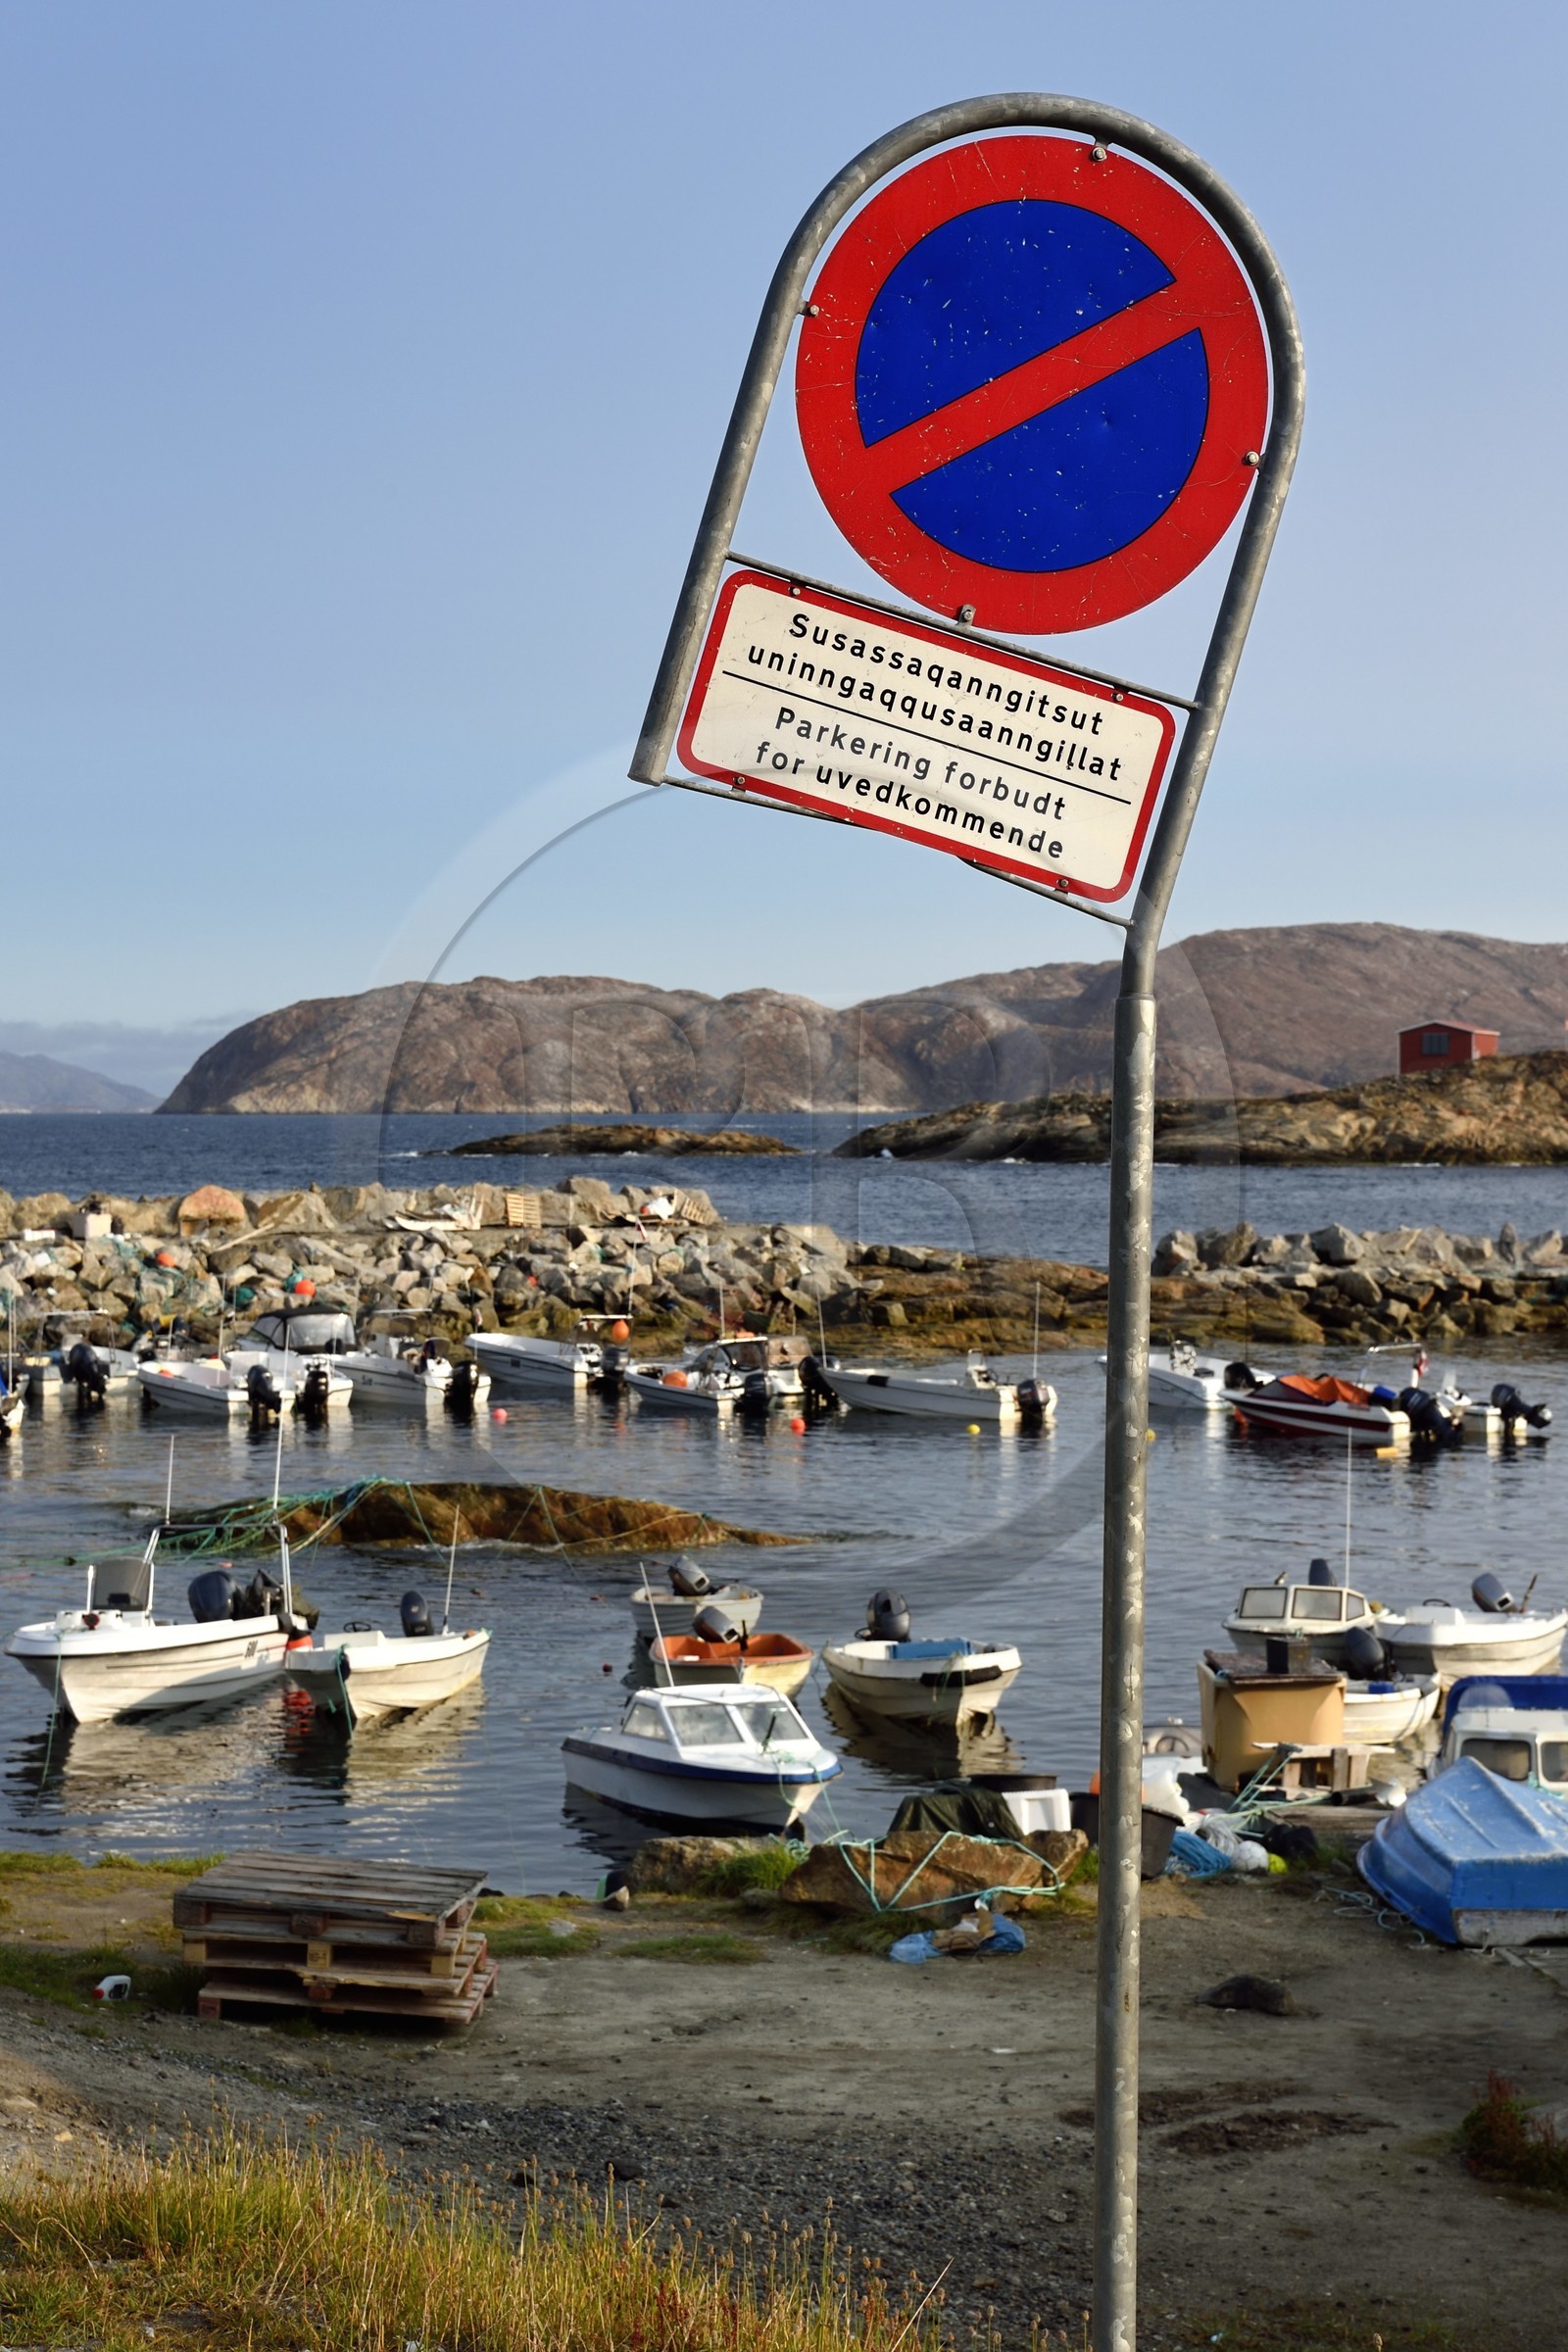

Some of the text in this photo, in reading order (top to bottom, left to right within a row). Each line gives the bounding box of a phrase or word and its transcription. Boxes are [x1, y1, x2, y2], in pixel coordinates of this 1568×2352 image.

[748, 645, 1122, 781] uninngaqqusaanngillat
[788, 612, 1103, 736] Susassaqanngitsut
[756, 741, 1063, 858] for uvedkommende
[774, 706, 1066, 820] Parkering forbudt
